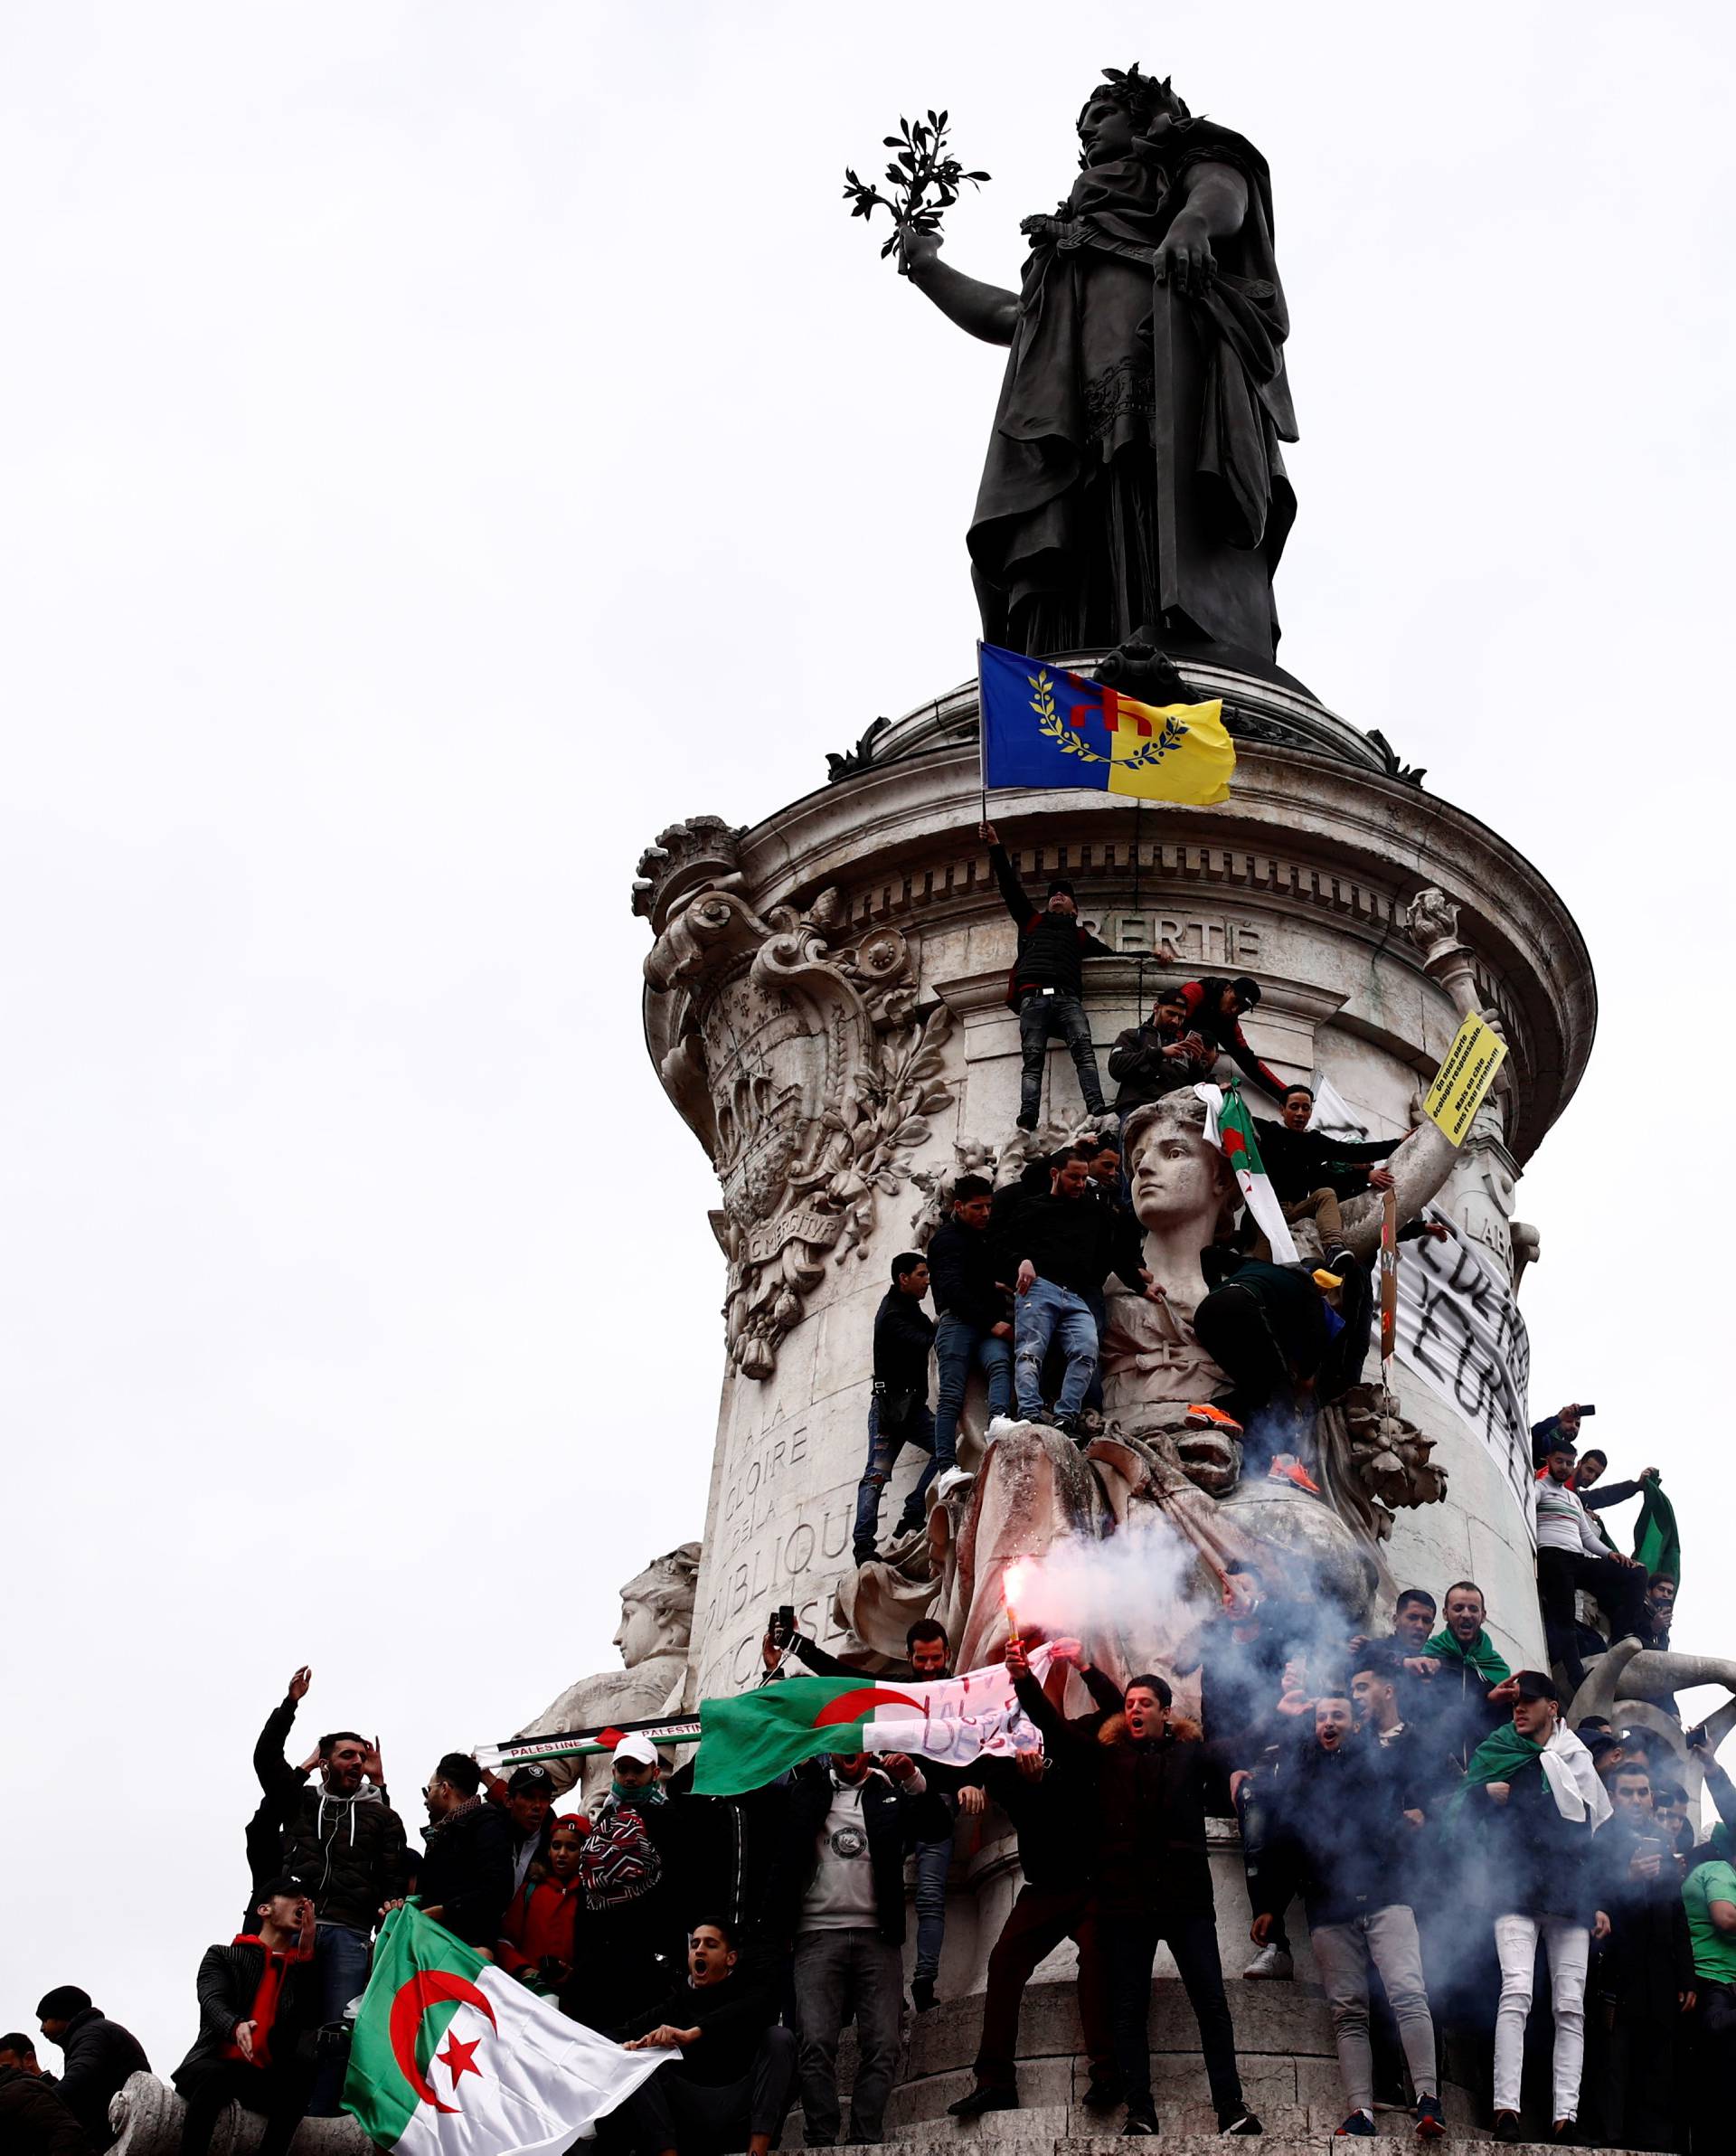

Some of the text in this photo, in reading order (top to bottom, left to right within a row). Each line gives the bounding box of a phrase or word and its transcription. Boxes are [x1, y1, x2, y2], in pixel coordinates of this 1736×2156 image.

[1455, 1091, 1467, 1111] Mais
[1467, 1079, 1475, 1091] on
[641, 1723, 702, 1737] PALESTIN
[511, 1740, 582, 1757] PALESTINE
